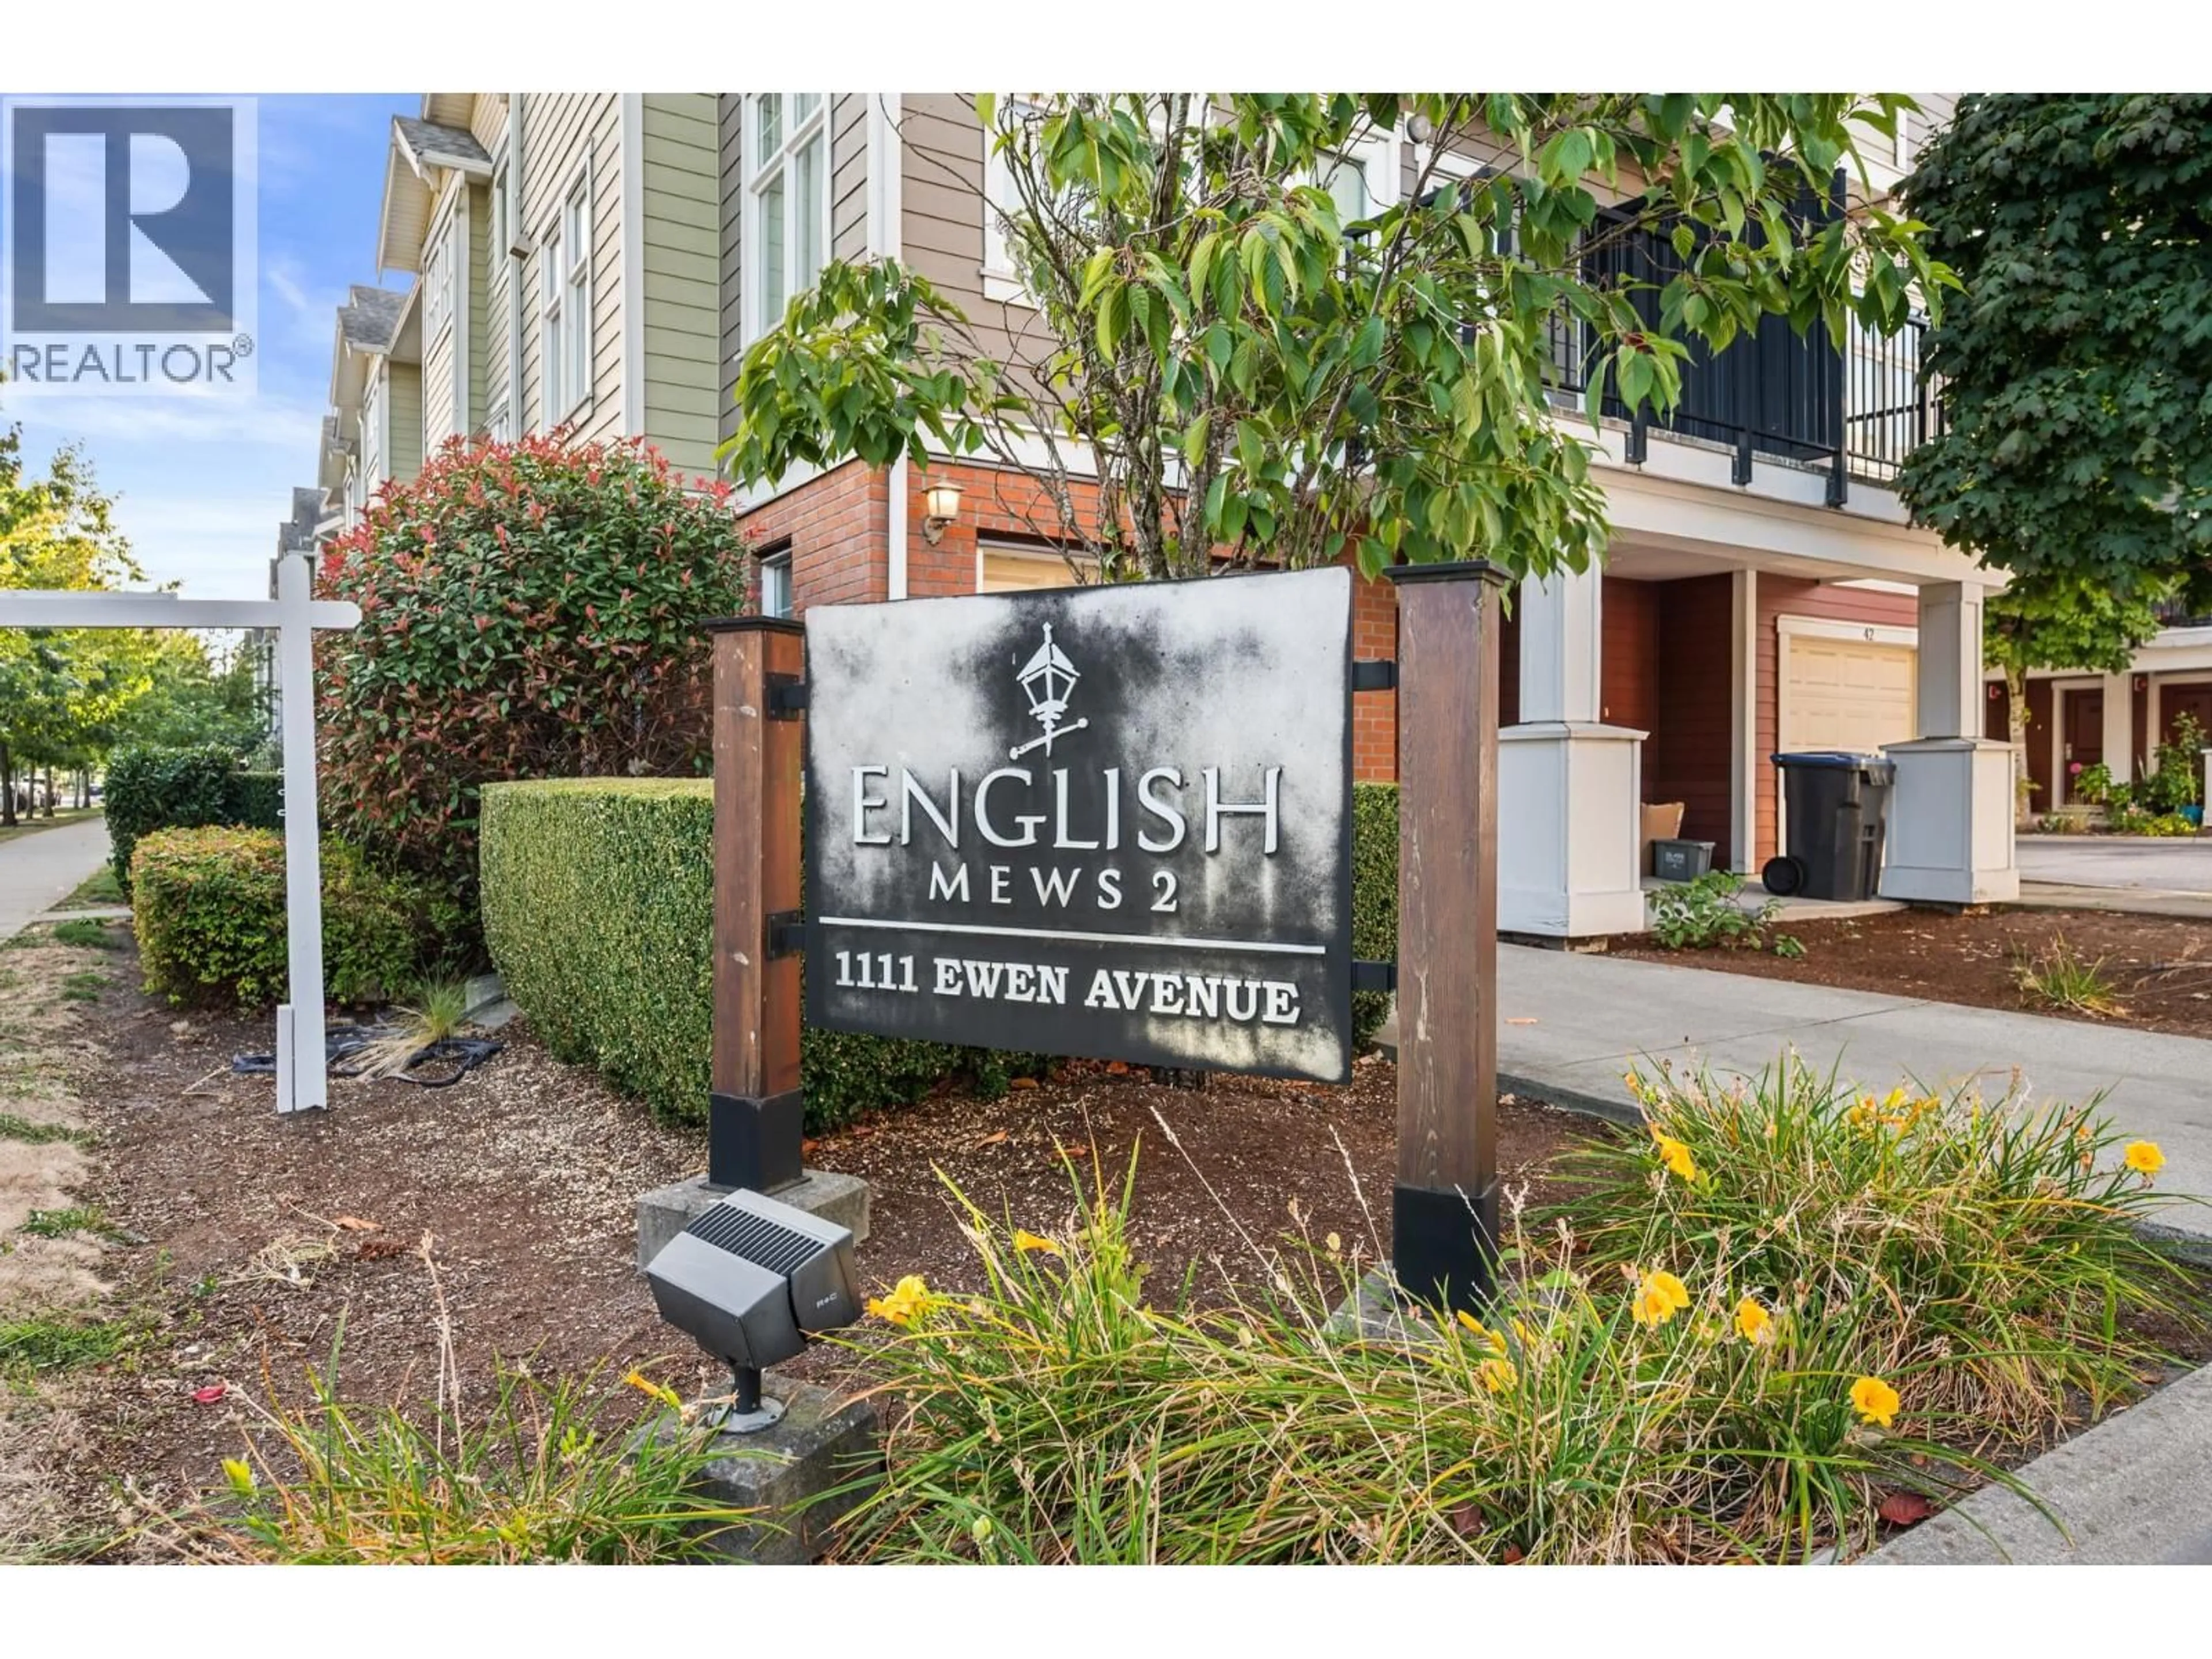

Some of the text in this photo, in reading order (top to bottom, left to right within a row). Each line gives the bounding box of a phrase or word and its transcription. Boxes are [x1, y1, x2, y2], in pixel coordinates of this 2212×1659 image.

[1863, 627, 1874, 640] 42
[851, 765, 1281, 855] ENGLISH
[928, 861, 1178, 914] MEWS 2
[835, 950, 1301, 1025] 1111 EWEN AVENUE
